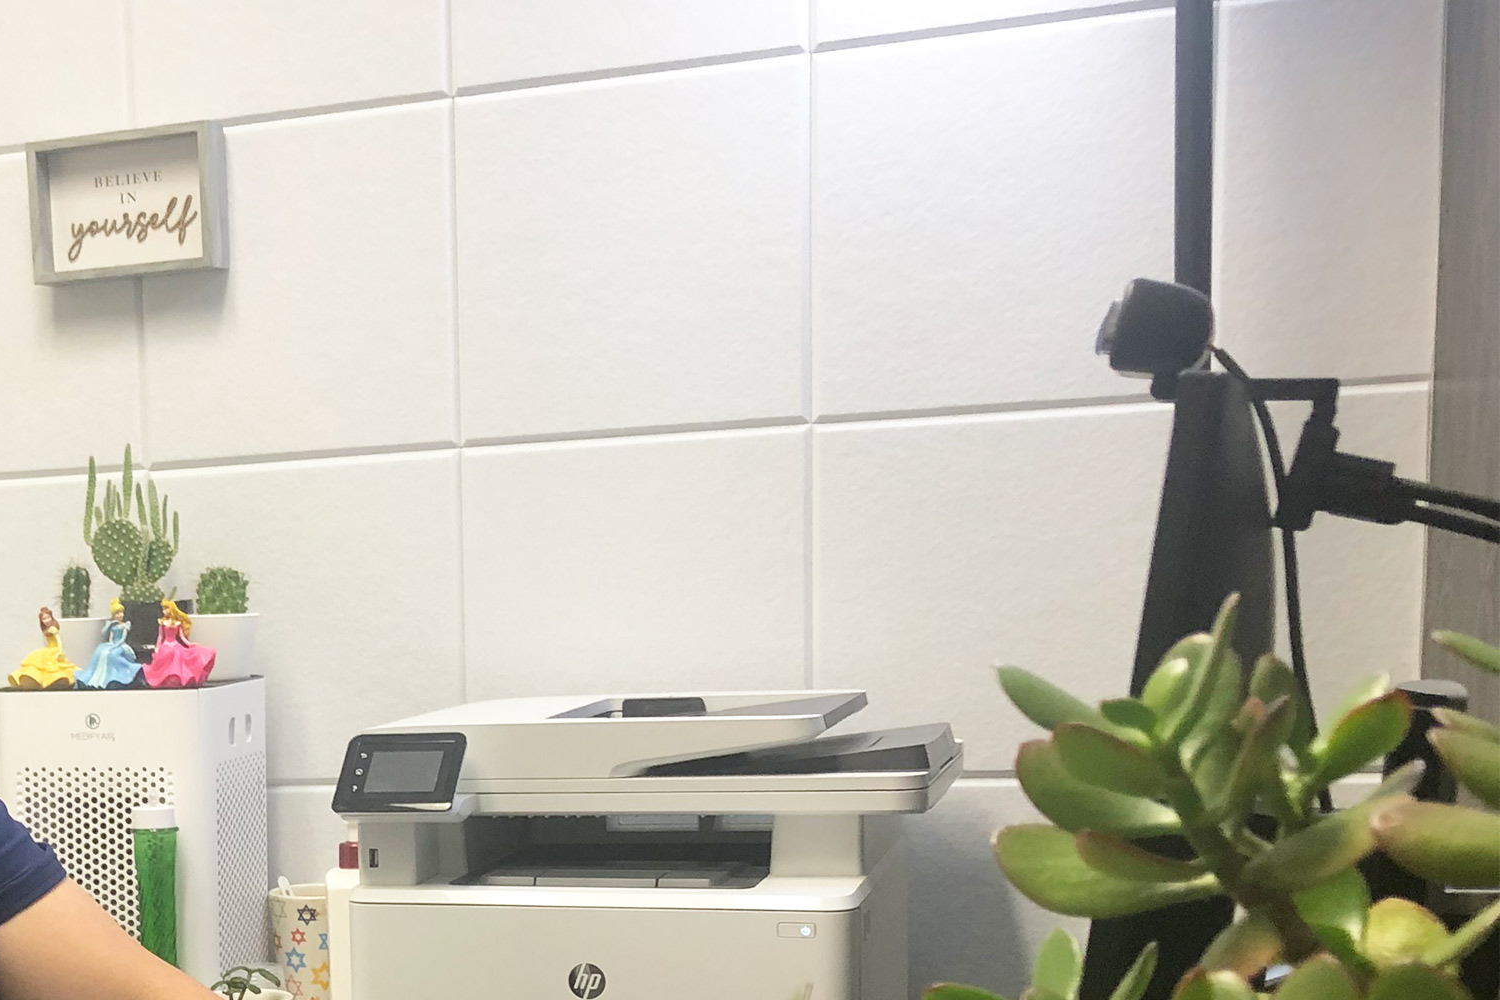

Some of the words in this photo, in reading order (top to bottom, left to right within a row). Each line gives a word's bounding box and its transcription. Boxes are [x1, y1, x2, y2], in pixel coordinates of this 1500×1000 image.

[94, 170, 164, 189] BELIEVE
[119, 191, 137, 205] IN
[67, 194, 198, 263] yourself
[572, 963, 604, 1000] hp
